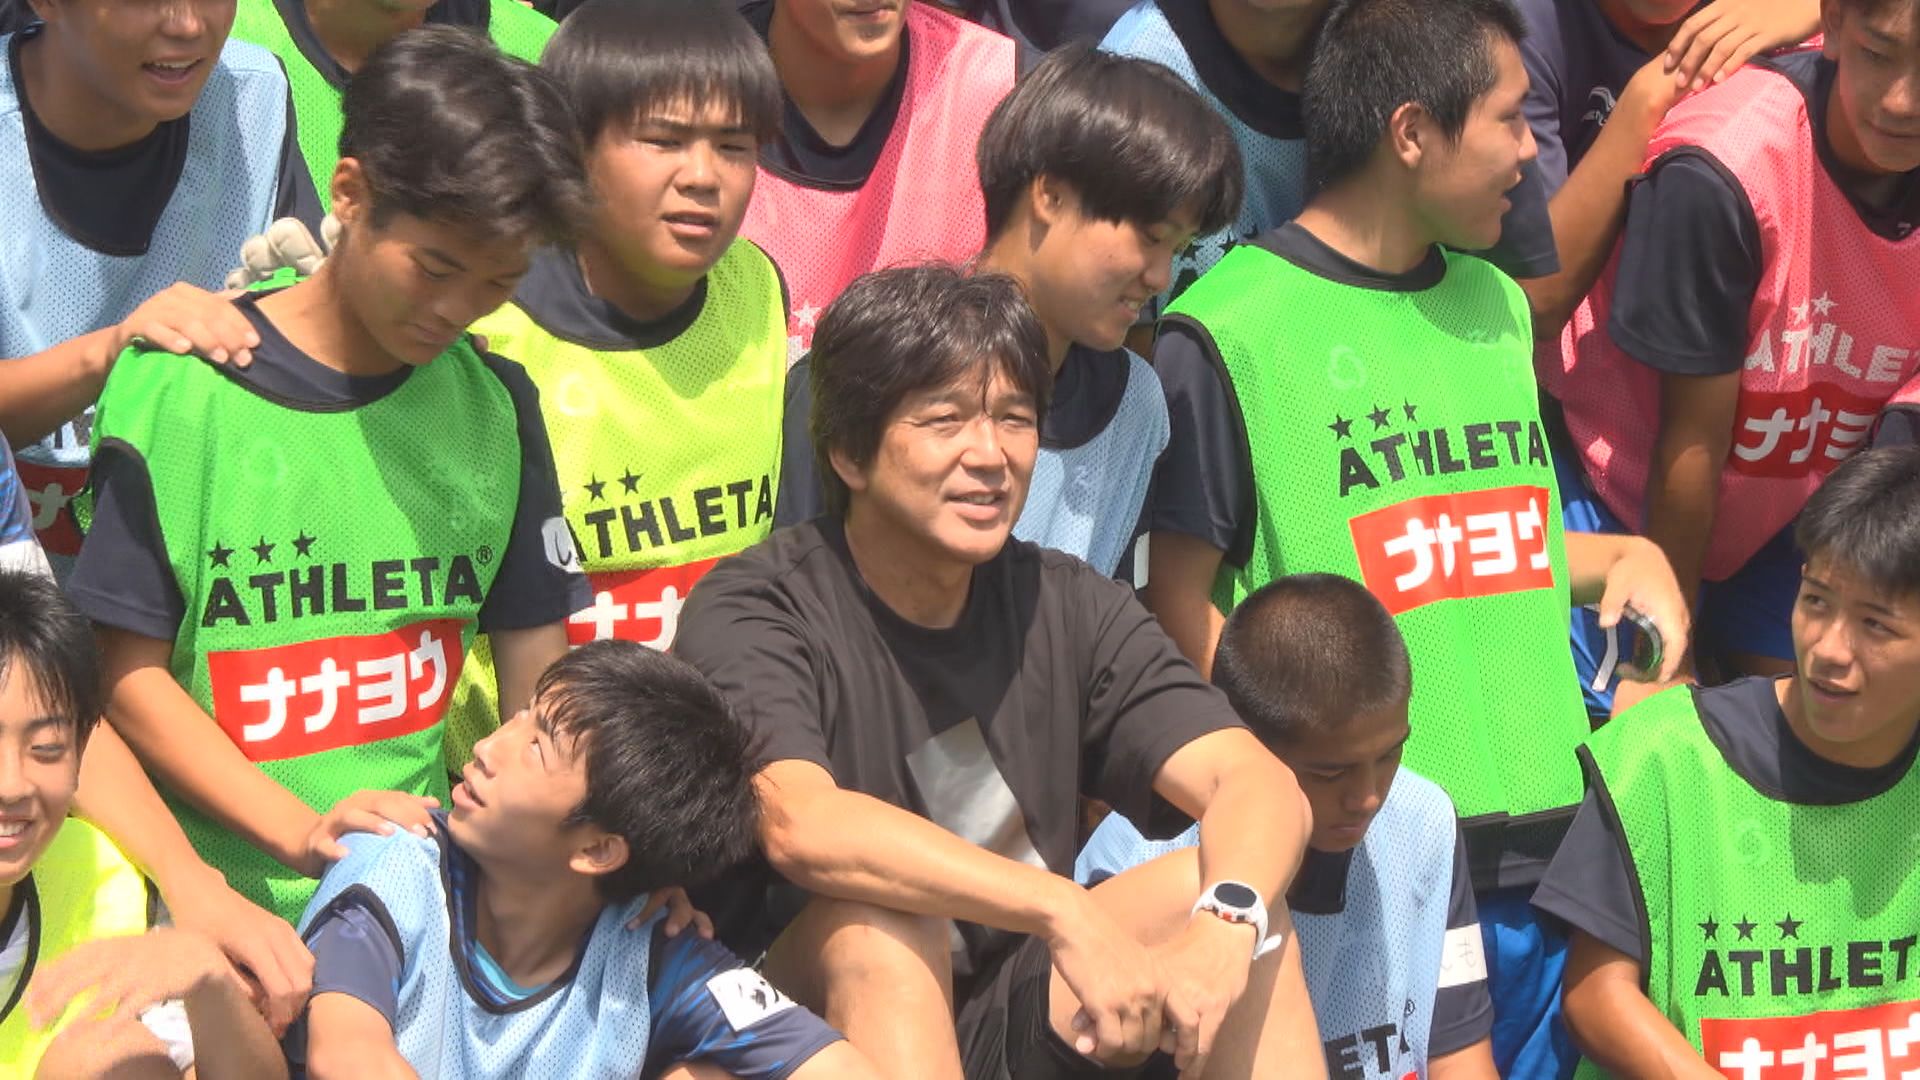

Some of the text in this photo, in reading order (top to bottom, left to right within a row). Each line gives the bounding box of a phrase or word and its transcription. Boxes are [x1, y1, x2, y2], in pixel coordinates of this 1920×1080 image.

[1744, 322, 1920, 383] ATHLE
[1339, 420, 1549, 498] ATHLETA
[239, 629, 448, 742] ナナヨウ
[1694, 934, 1920, 997] ATHLET
